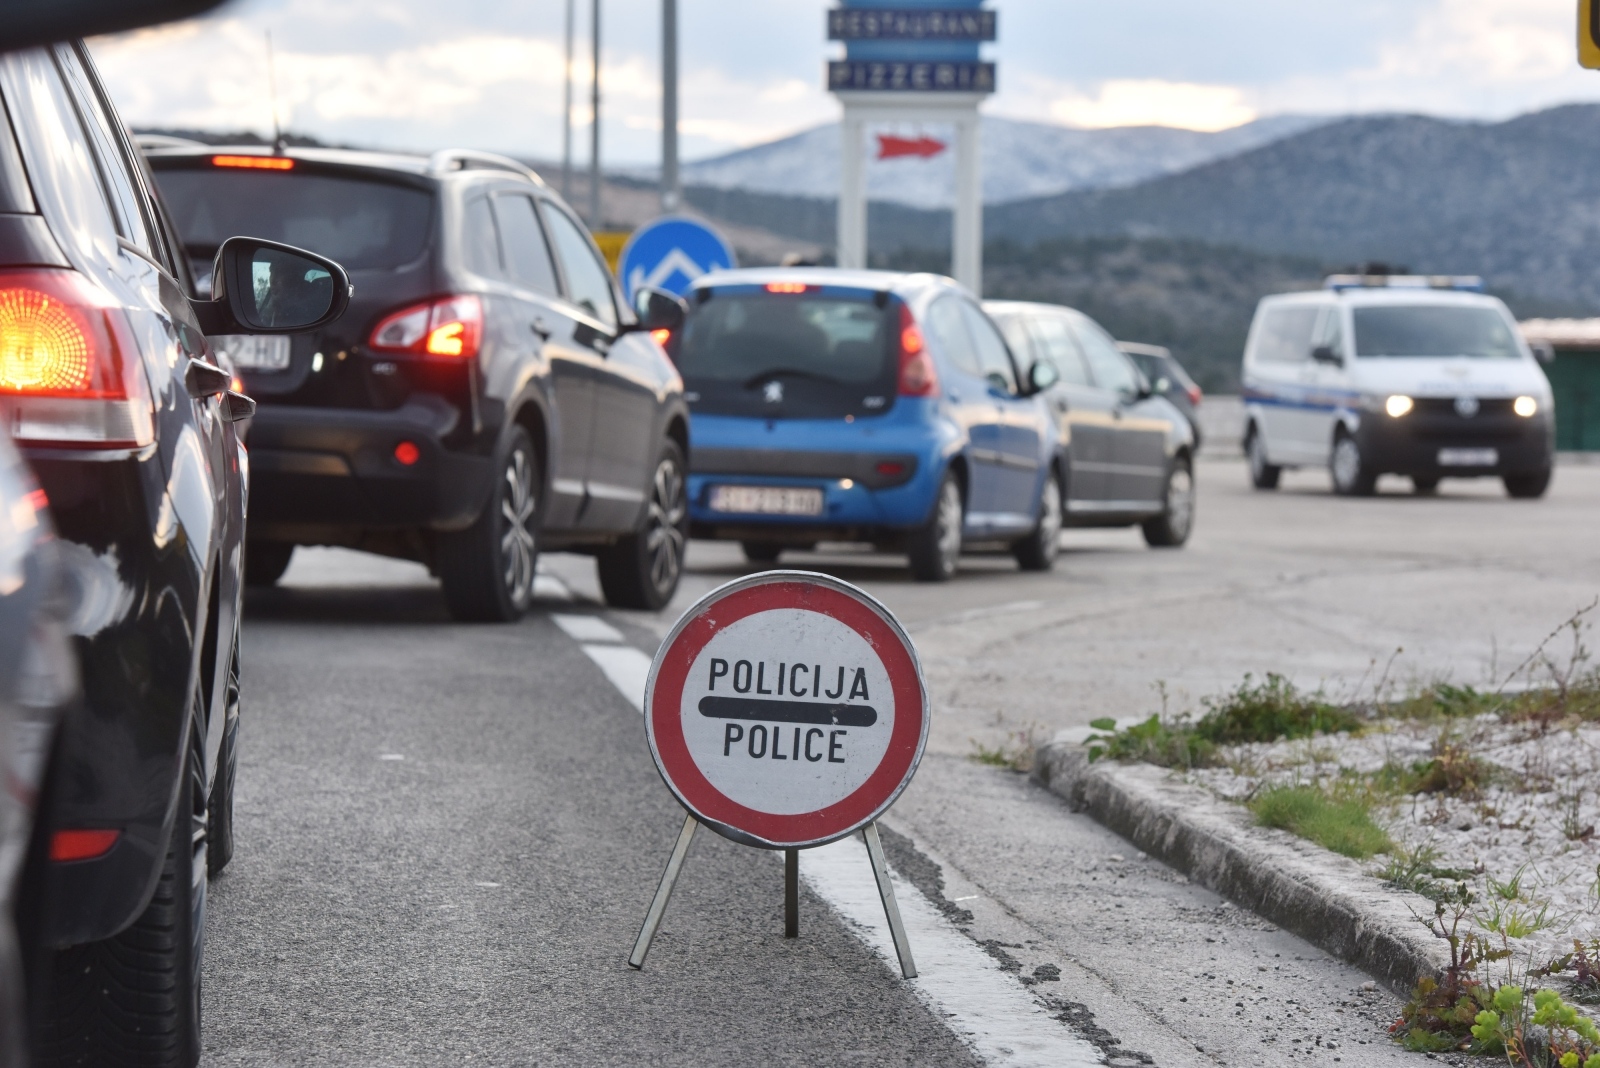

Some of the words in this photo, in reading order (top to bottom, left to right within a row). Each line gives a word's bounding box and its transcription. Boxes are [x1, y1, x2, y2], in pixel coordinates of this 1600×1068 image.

[834, 11, 993, 38] RESTAURANT
[830, 63, 993, 88] PIZZERIA
[708, 658, 869, 700] POLICIJA
[723, 723, 847, 763] POLICE
